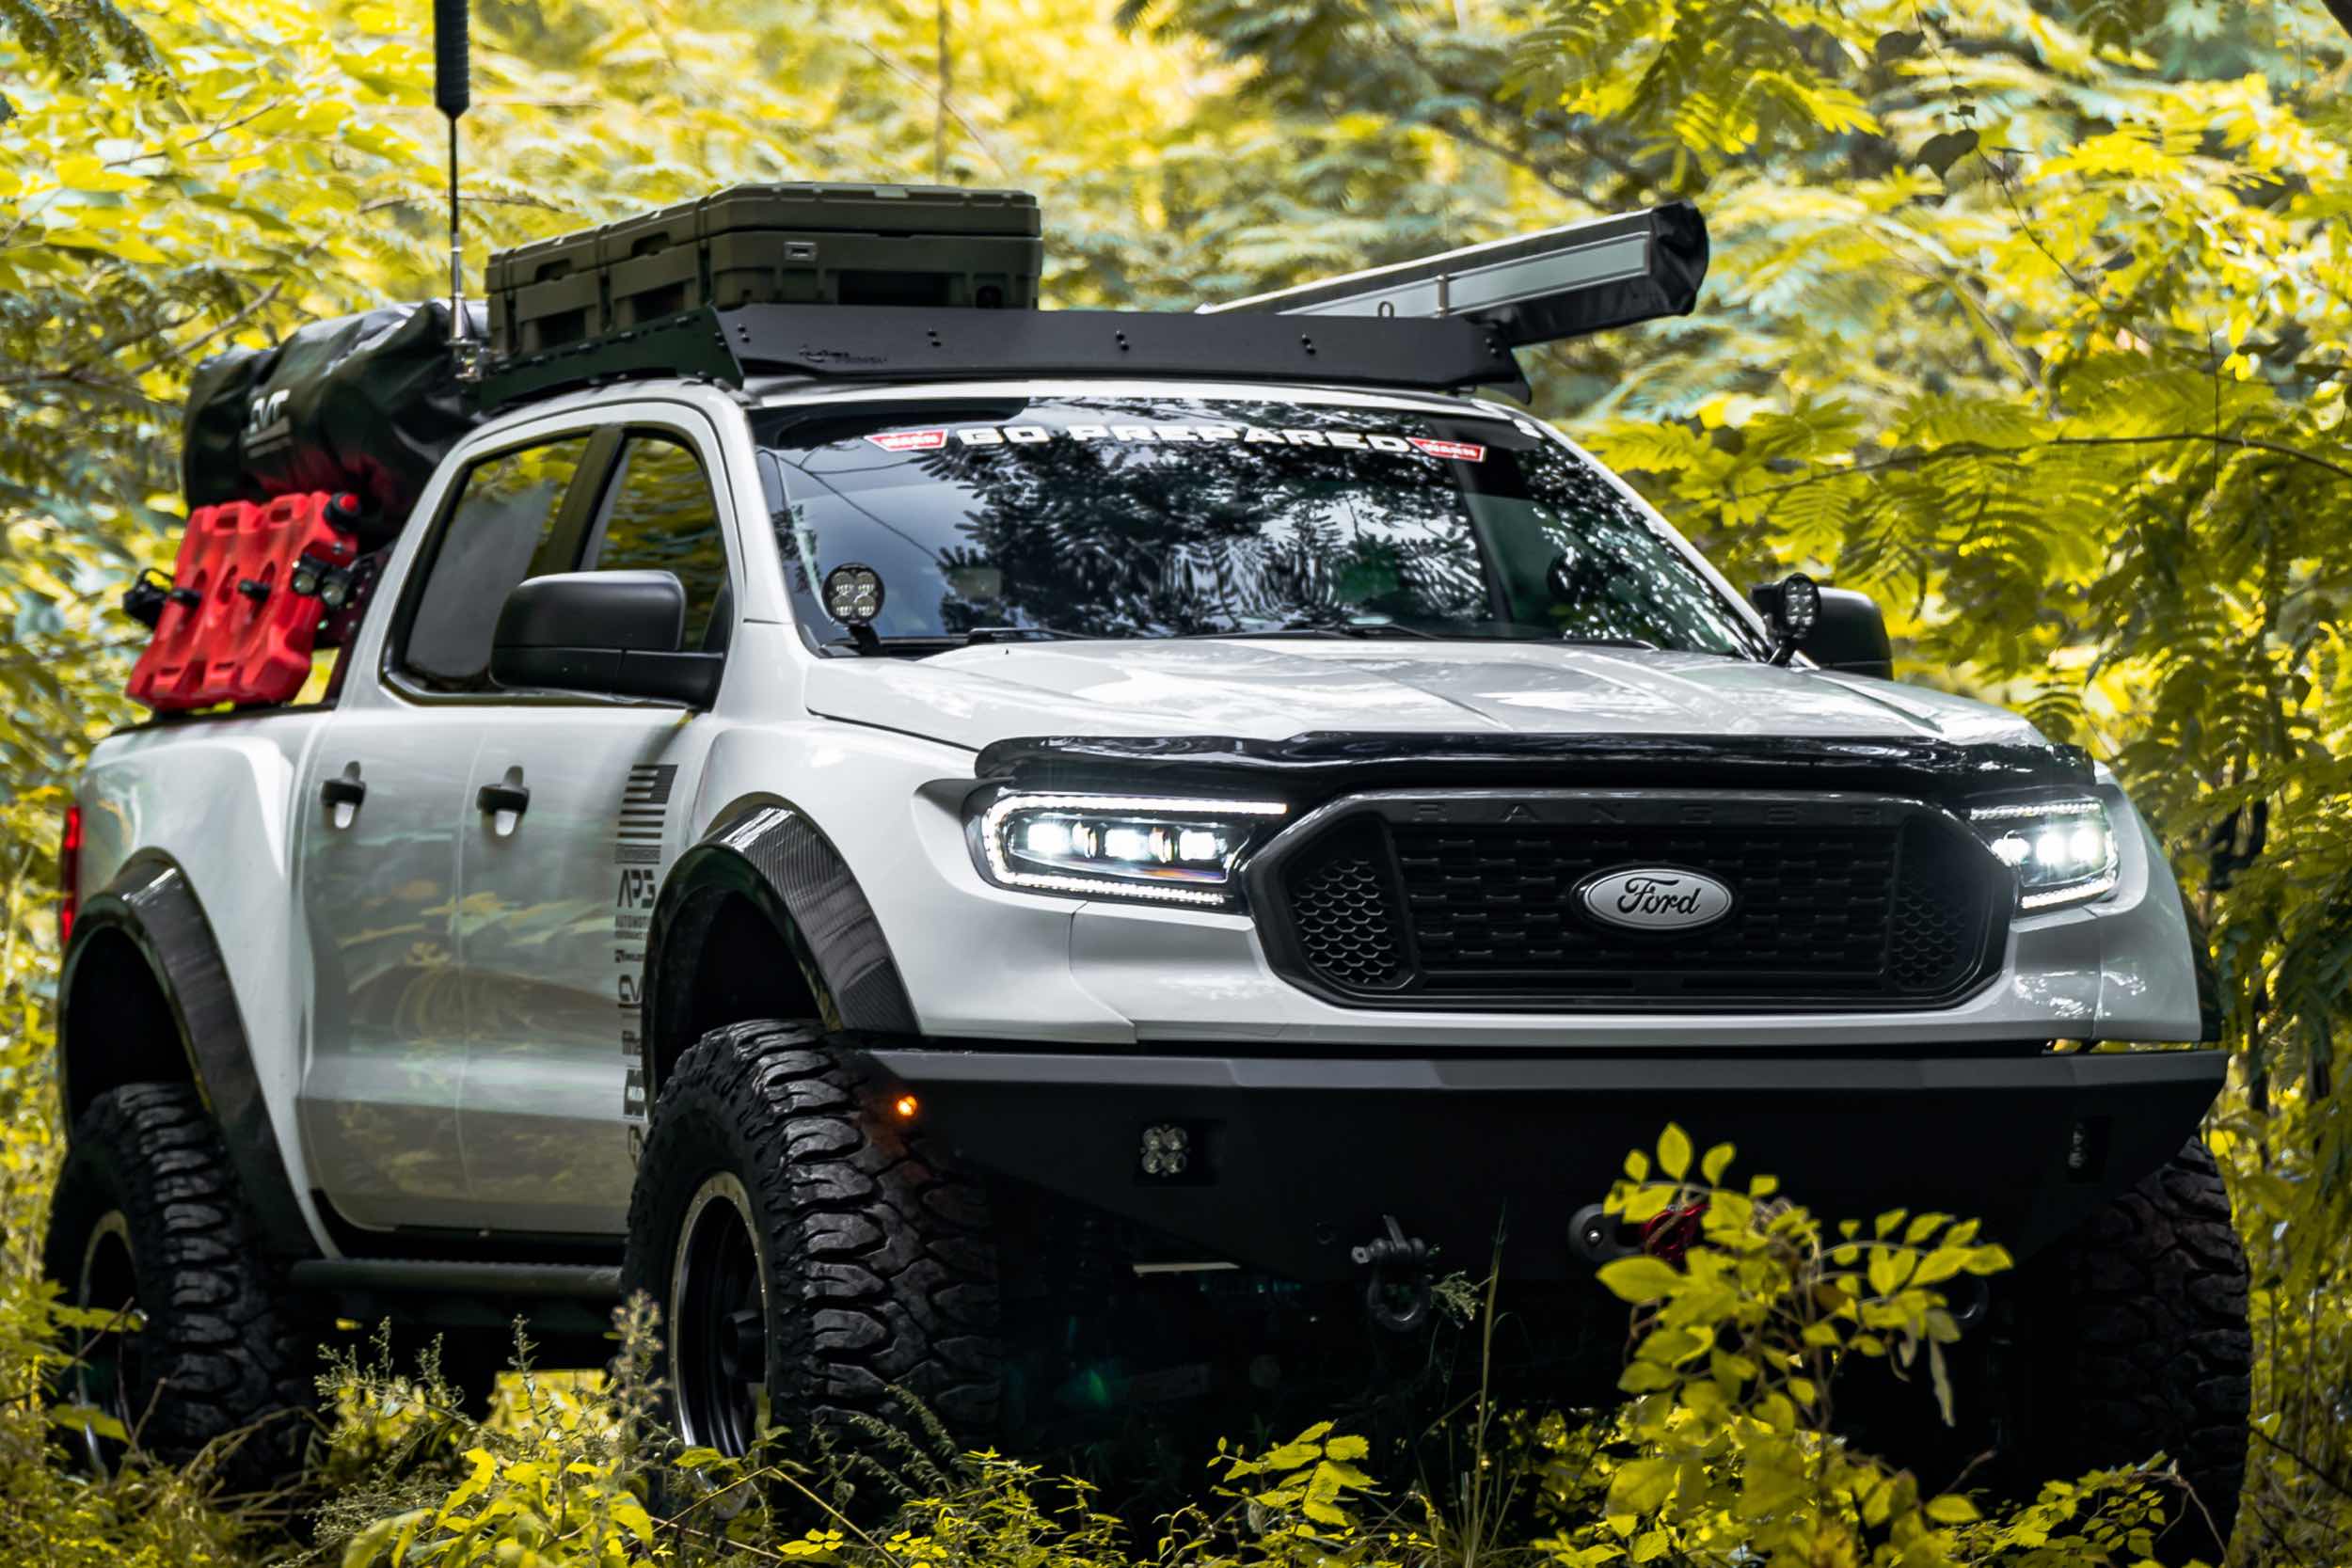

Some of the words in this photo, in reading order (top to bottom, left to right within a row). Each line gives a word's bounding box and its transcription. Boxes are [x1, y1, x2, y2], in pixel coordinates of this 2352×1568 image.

[956, 426, 1052, 446] GO
[1066, 425, 1410, 451] PREPARED
[1617, 876, 1701, 915] Ford
